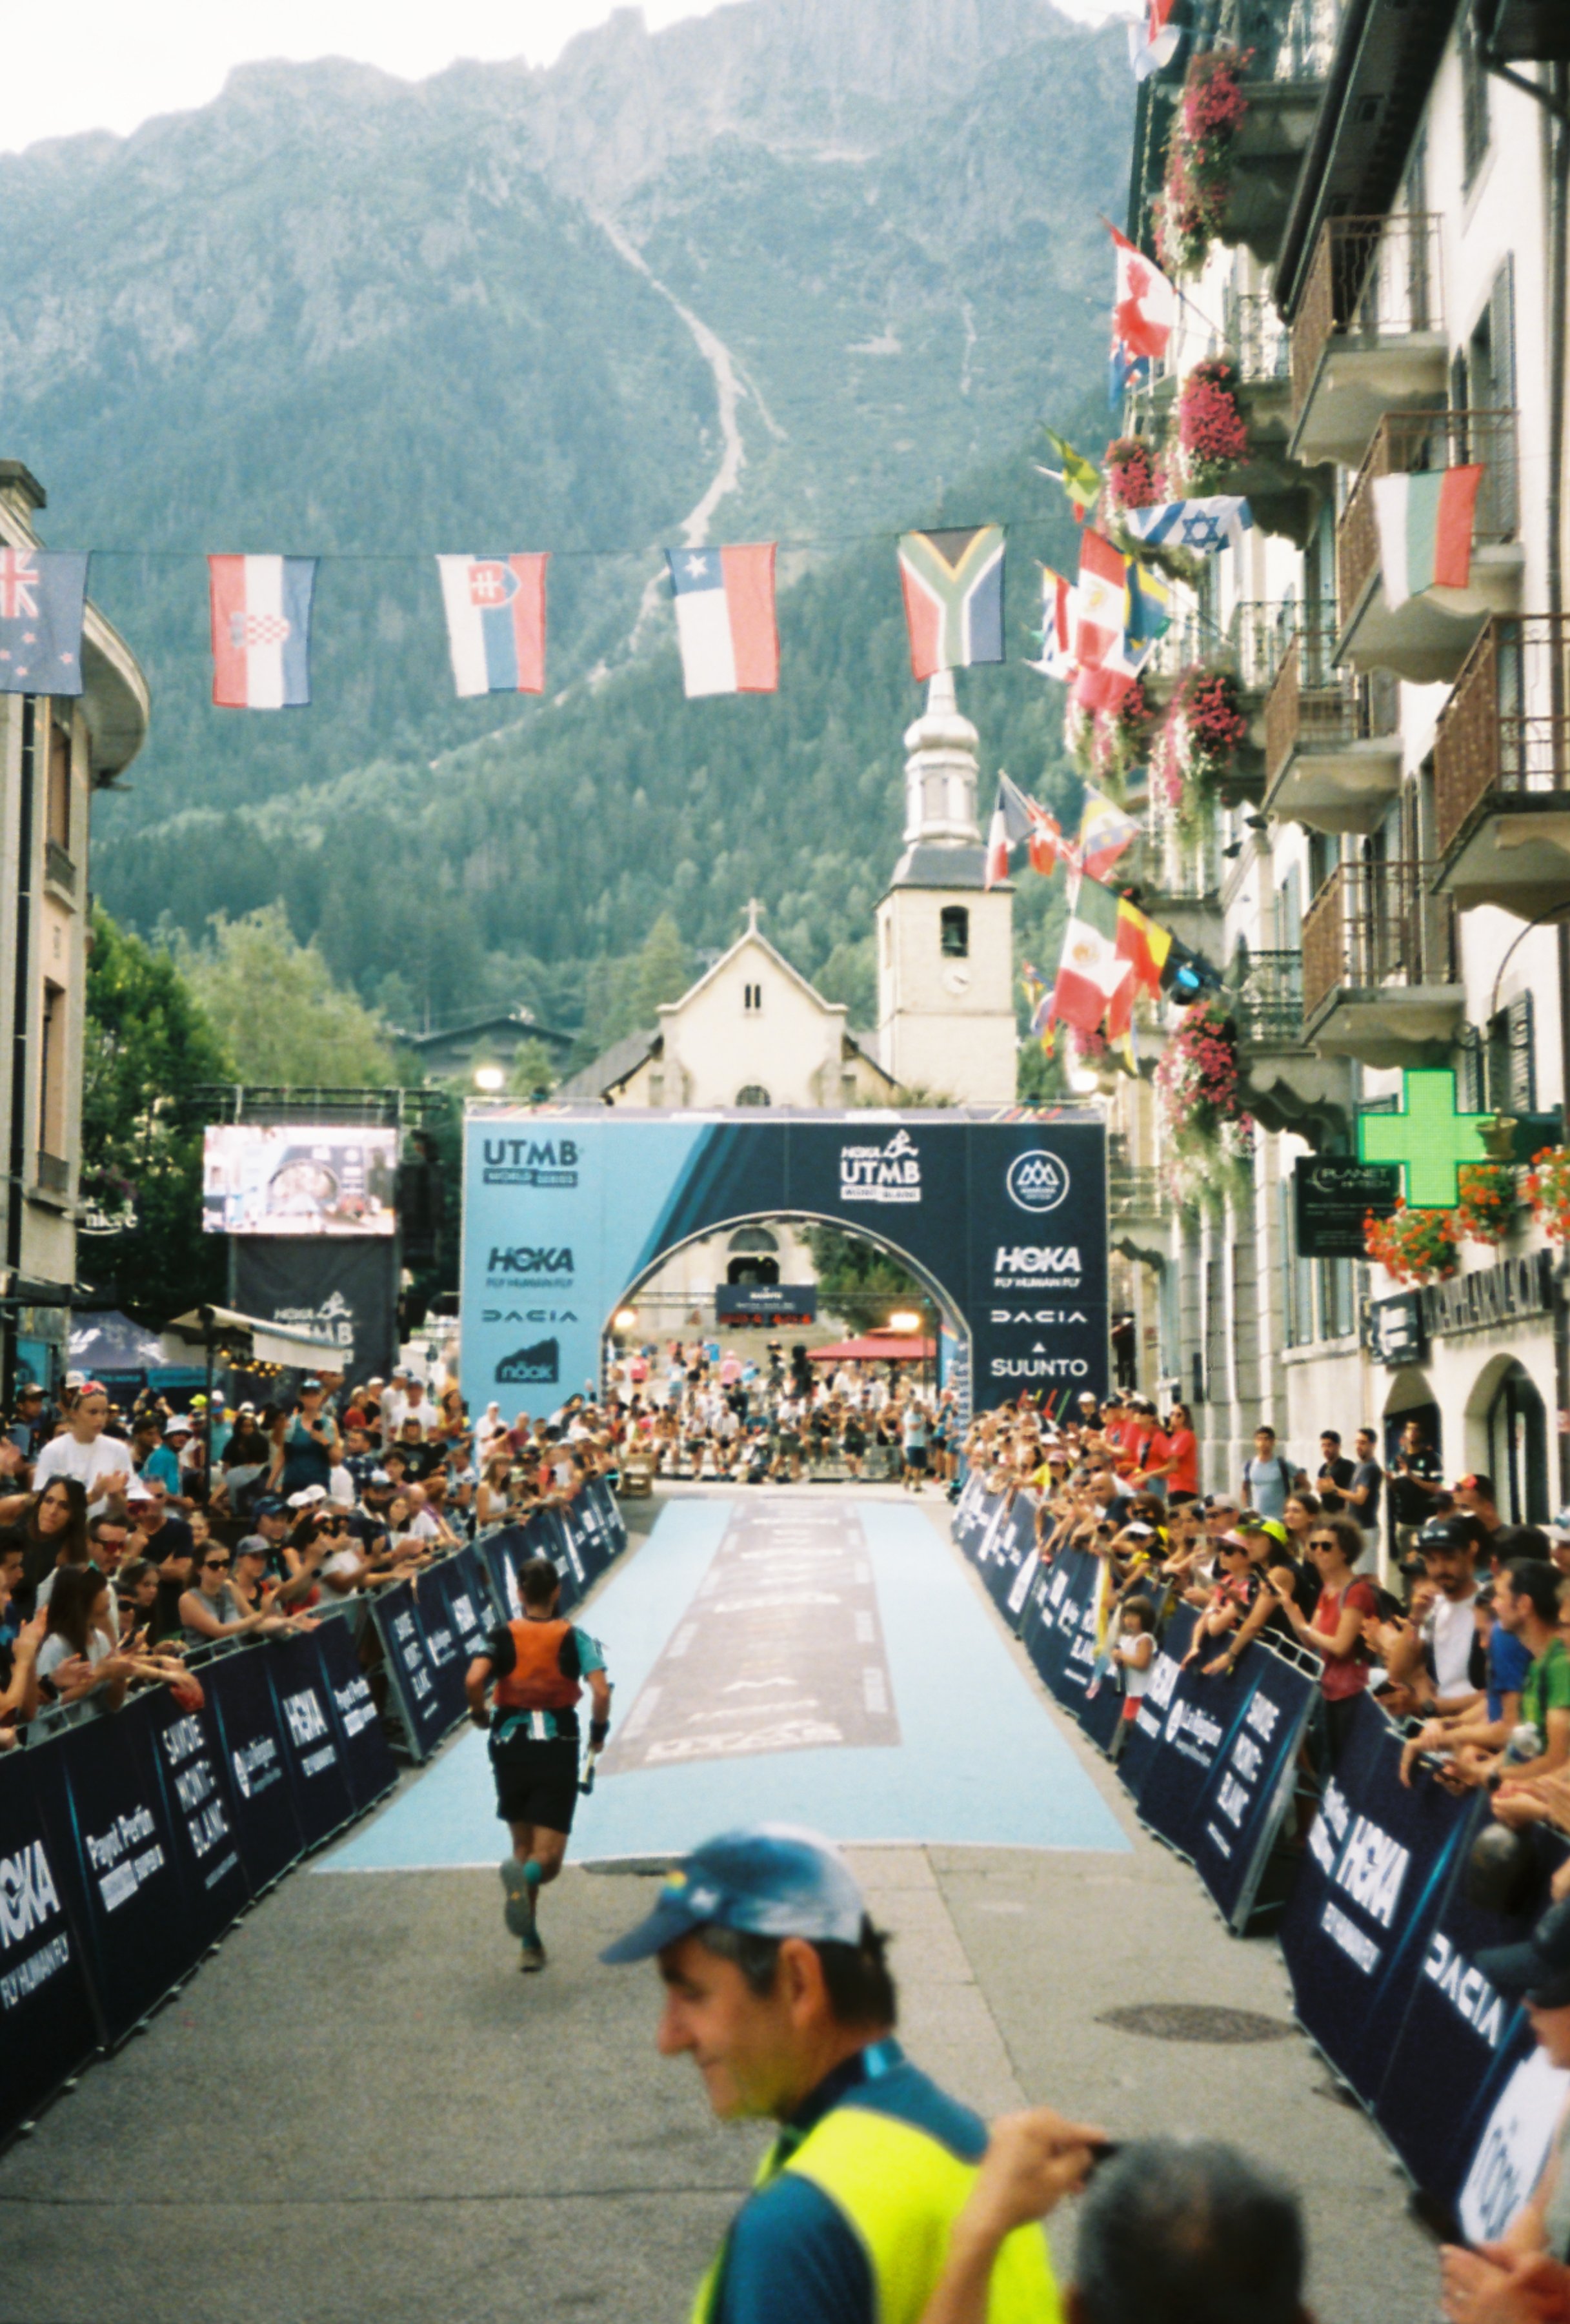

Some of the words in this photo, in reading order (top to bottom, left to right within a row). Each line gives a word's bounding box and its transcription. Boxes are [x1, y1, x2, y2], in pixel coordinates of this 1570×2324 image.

[484, 1139, 578, 1165] UTMB
[841, 1160, 921, 1184] UTMB
[488, 1246, 574, 1273] HOKA
[994, 1246, 1082, 1272] HOKA
[481, 1309, 578, 1322] DACIA
[991, 1310, 1087, 1322] DACIA
[991, 1359, 1089, 1376] SUUNTO
[1336, 1815, 1410, 1929] HOKA
[0, 1839, 61, 1950] OKA
[1424, 1932, 1502, 2048] DACIA
